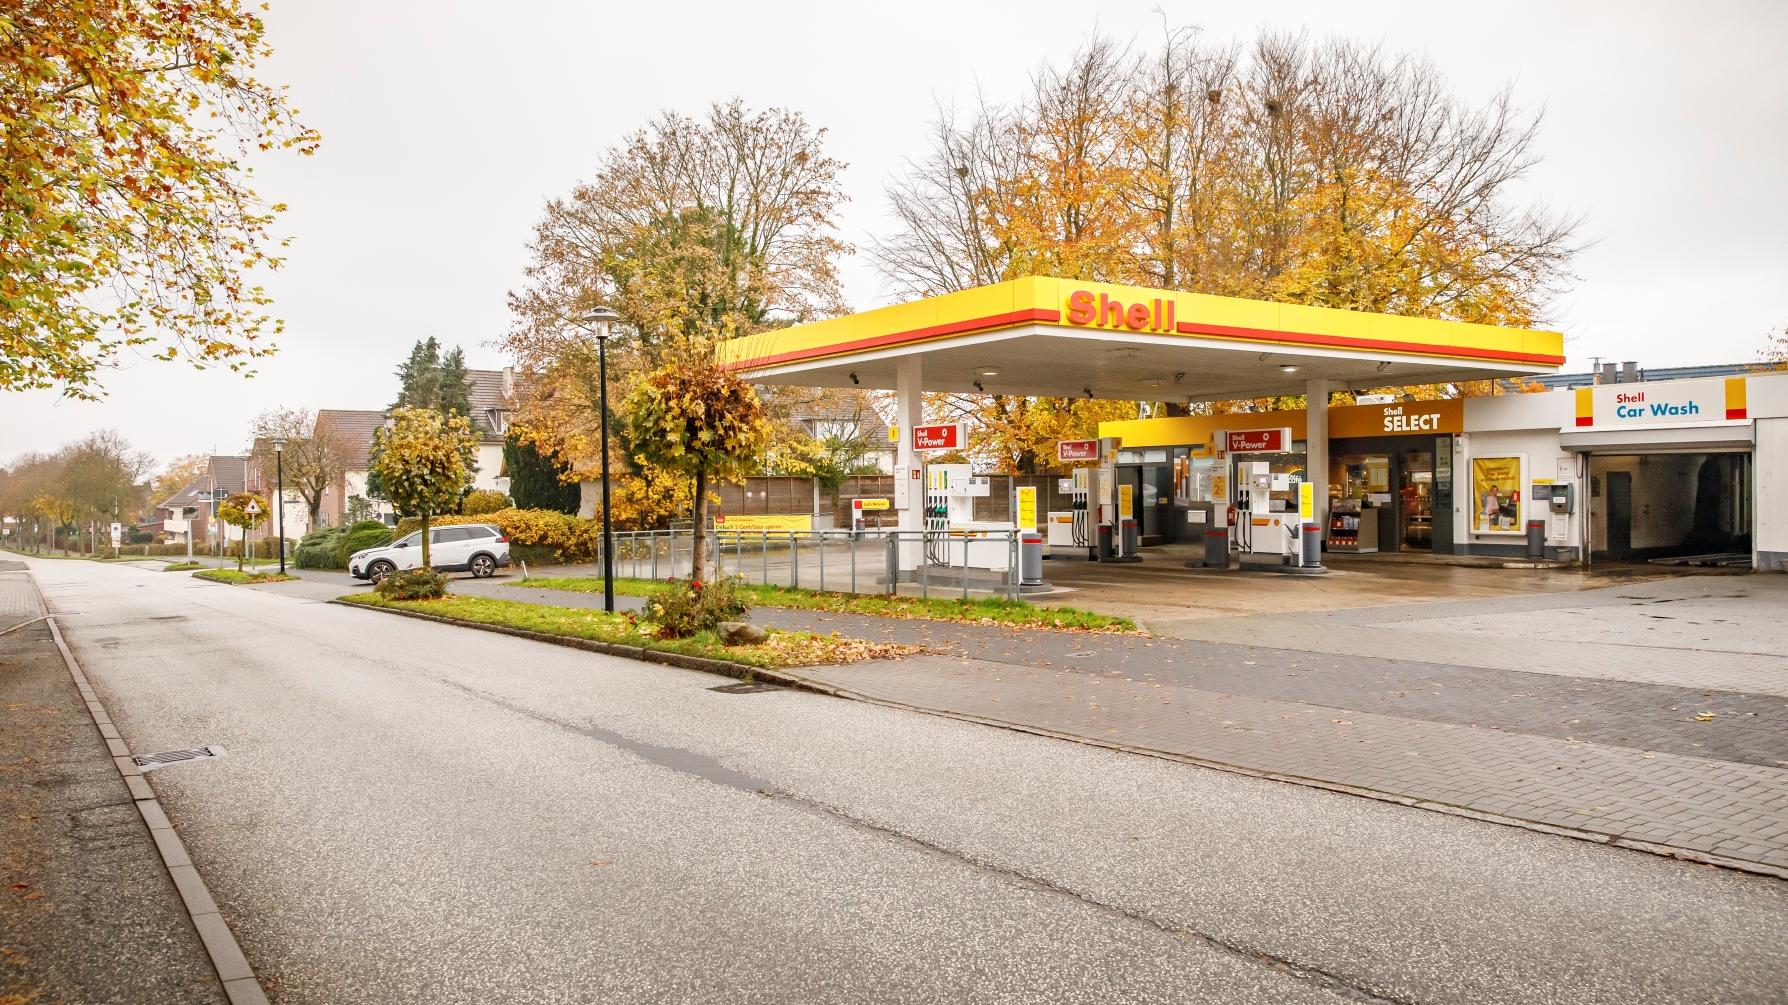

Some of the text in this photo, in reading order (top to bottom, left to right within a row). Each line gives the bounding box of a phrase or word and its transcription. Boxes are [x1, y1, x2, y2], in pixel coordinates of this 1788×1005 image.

[1067, 290, 1175, 332] Shell
[1616, 392, 1645, 404] Shell
[1383, 406, 1403, 416] Shell
[1616, 400, 1699, 418] Car Wash
[1383, 413, 1441, 432] SELECT
[916, 429, 928, 437] Shell
[916, 437, 945, 447] V-Power
[1232, 441, 1267, 450] V-Power
